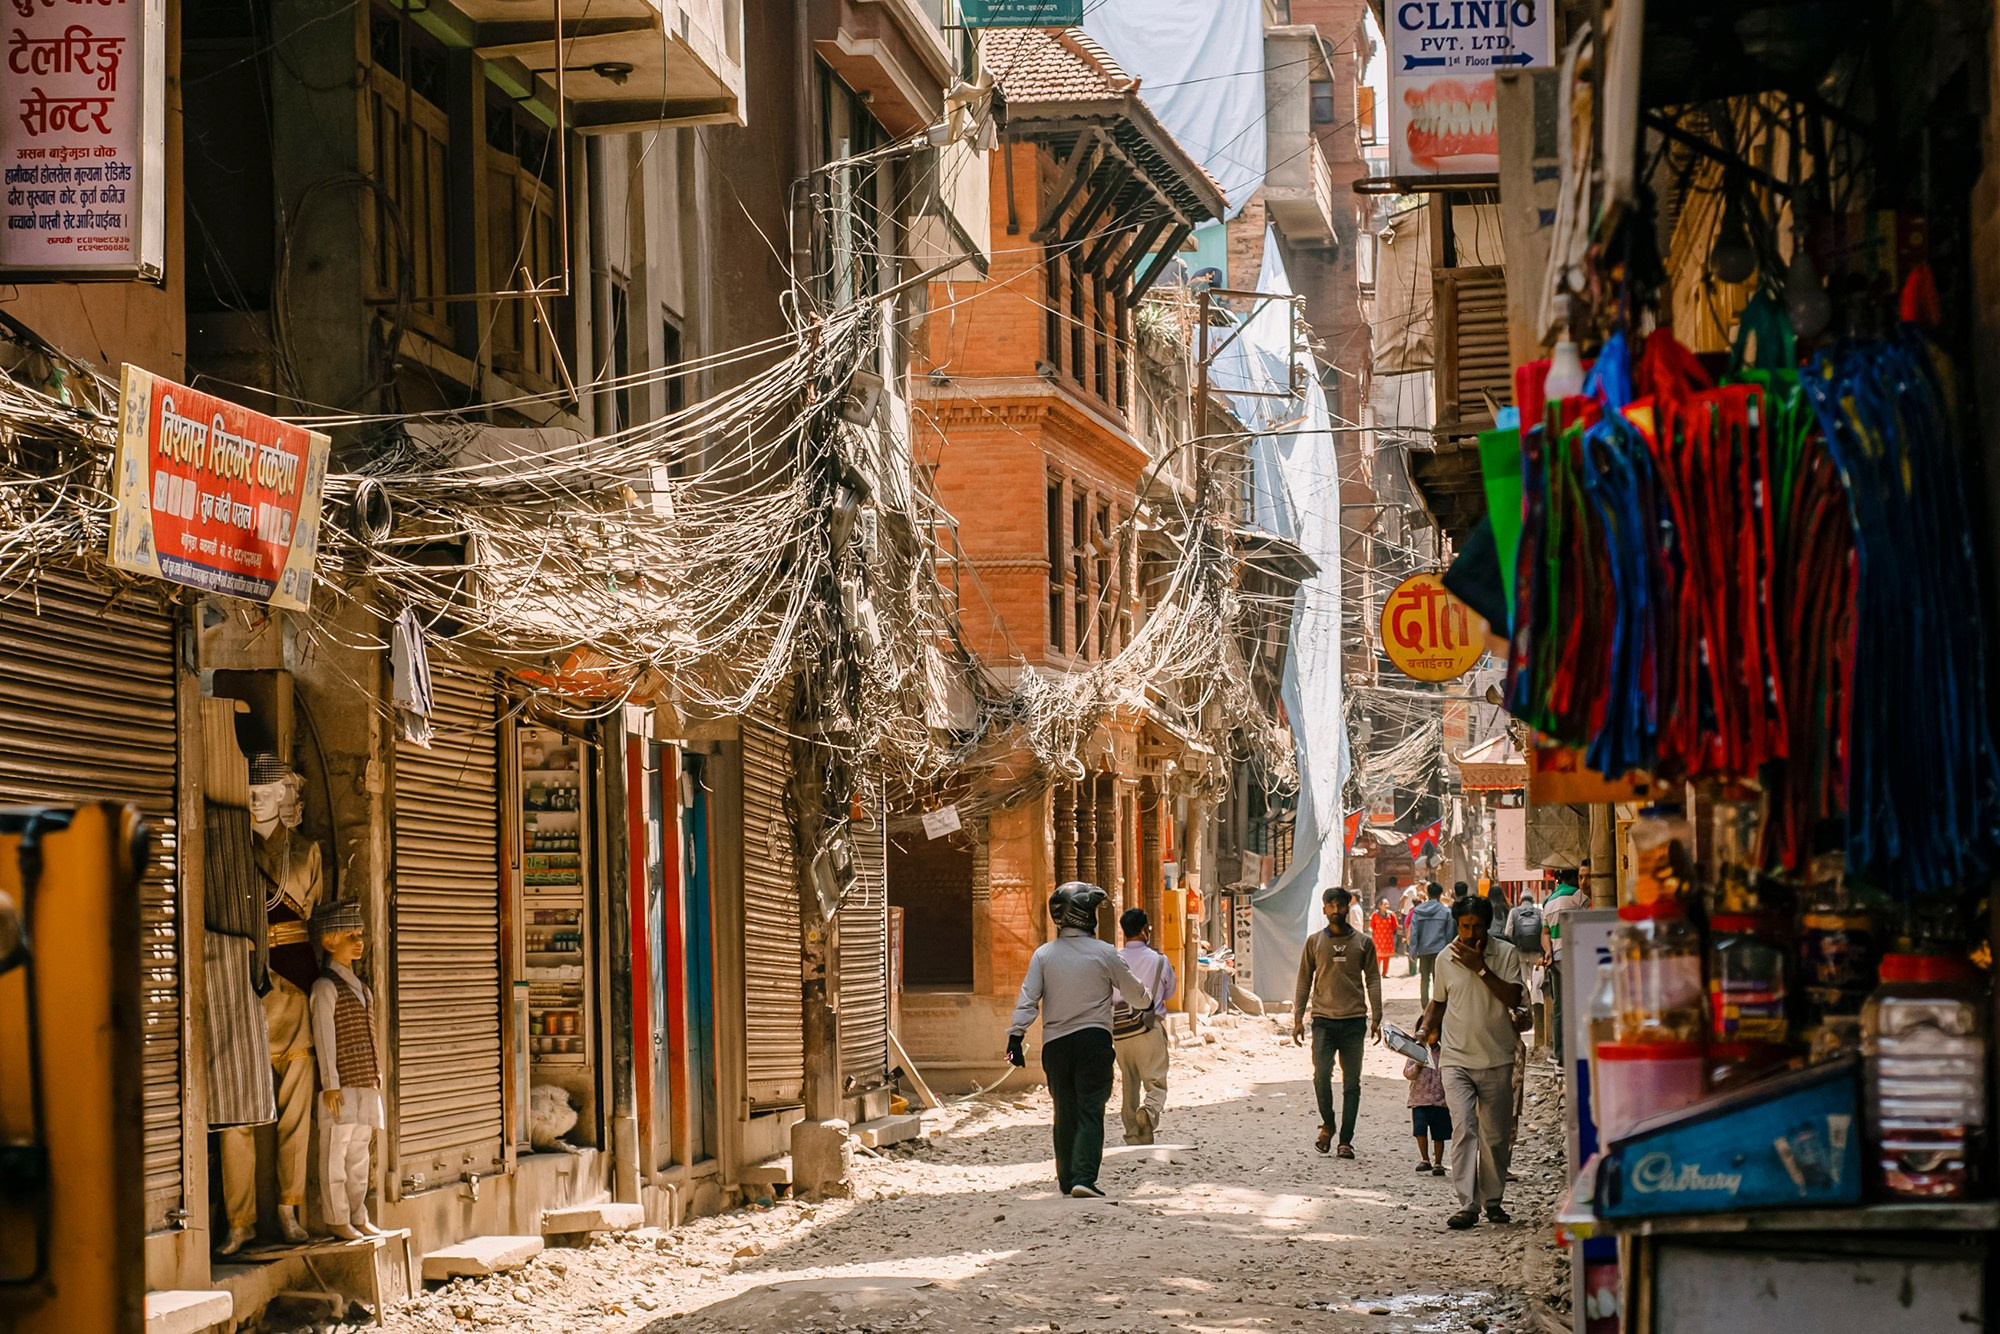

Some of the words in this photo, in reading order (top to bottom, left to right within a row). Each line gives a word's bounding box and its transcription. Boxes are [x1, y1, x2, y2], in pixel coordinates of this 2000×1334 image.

[1398, 0, 1537, 31] CLINIC
[1420, 37, 1464, 51] PVT.
[1472, 35, 1516, 50] LTD.
[1448, 56, 1461, 66] 1st
[1465, 55, 1490, 66] Floor
[20, 87, 115, 137] सेन्टर
[17, 148, 46, 159] असन
[93, 144, 117, 157] चोक
[40, 163, 72, 184] होलसेल
[104, 161, 132, 182] रेडिमेड
[100, 184, 125, 204] कमिज
[63, 210, 76, 230] सेट
[76, 209, 95, 229] आदि
[158, 394, 209, 471] विश्वास
[208, 412, 257, 487] सिल्भर
[257, 437, 300, 496] वर्कशप
